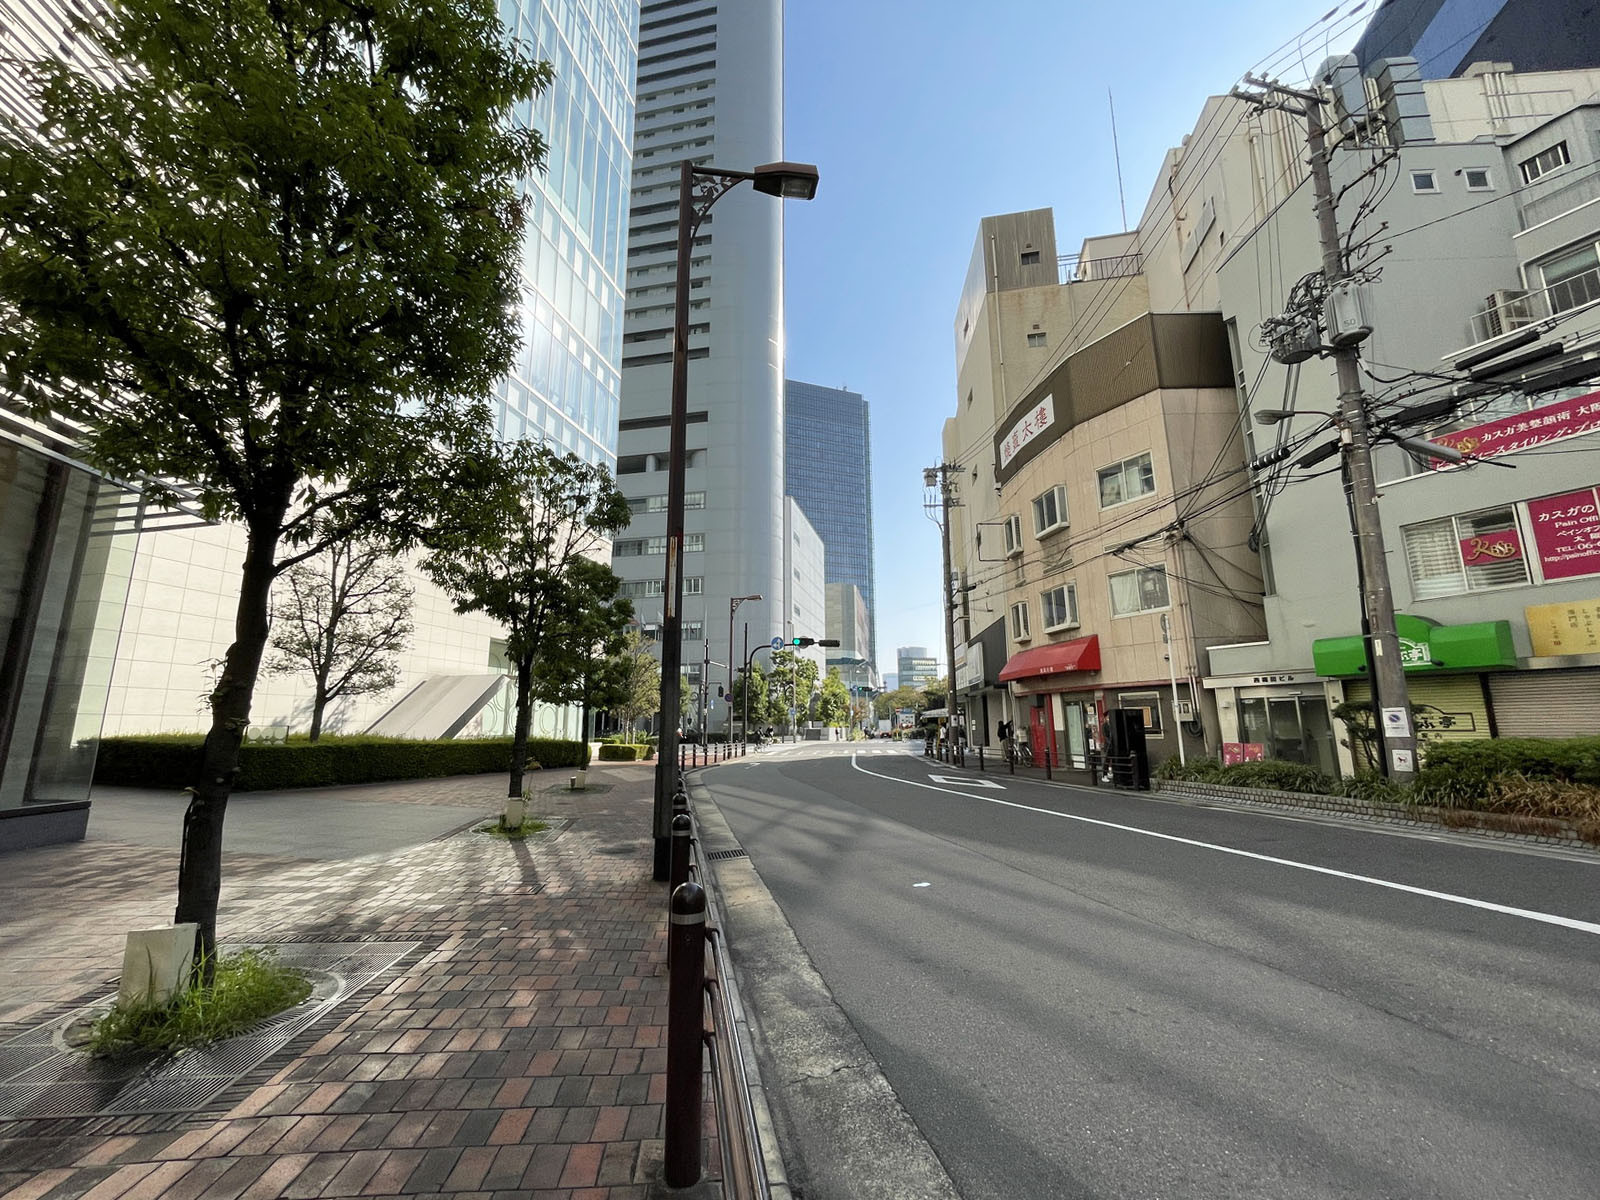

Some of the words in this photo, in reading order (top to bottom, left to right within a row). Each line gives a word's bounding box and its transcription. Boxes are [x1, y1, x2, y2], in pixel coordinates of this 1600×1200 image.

[1481, 410, 1571, 443] カスガ美整顔術
[1538, 504, 1595, 522] カスガの
[1554, 519, 1578, 529] Pain
